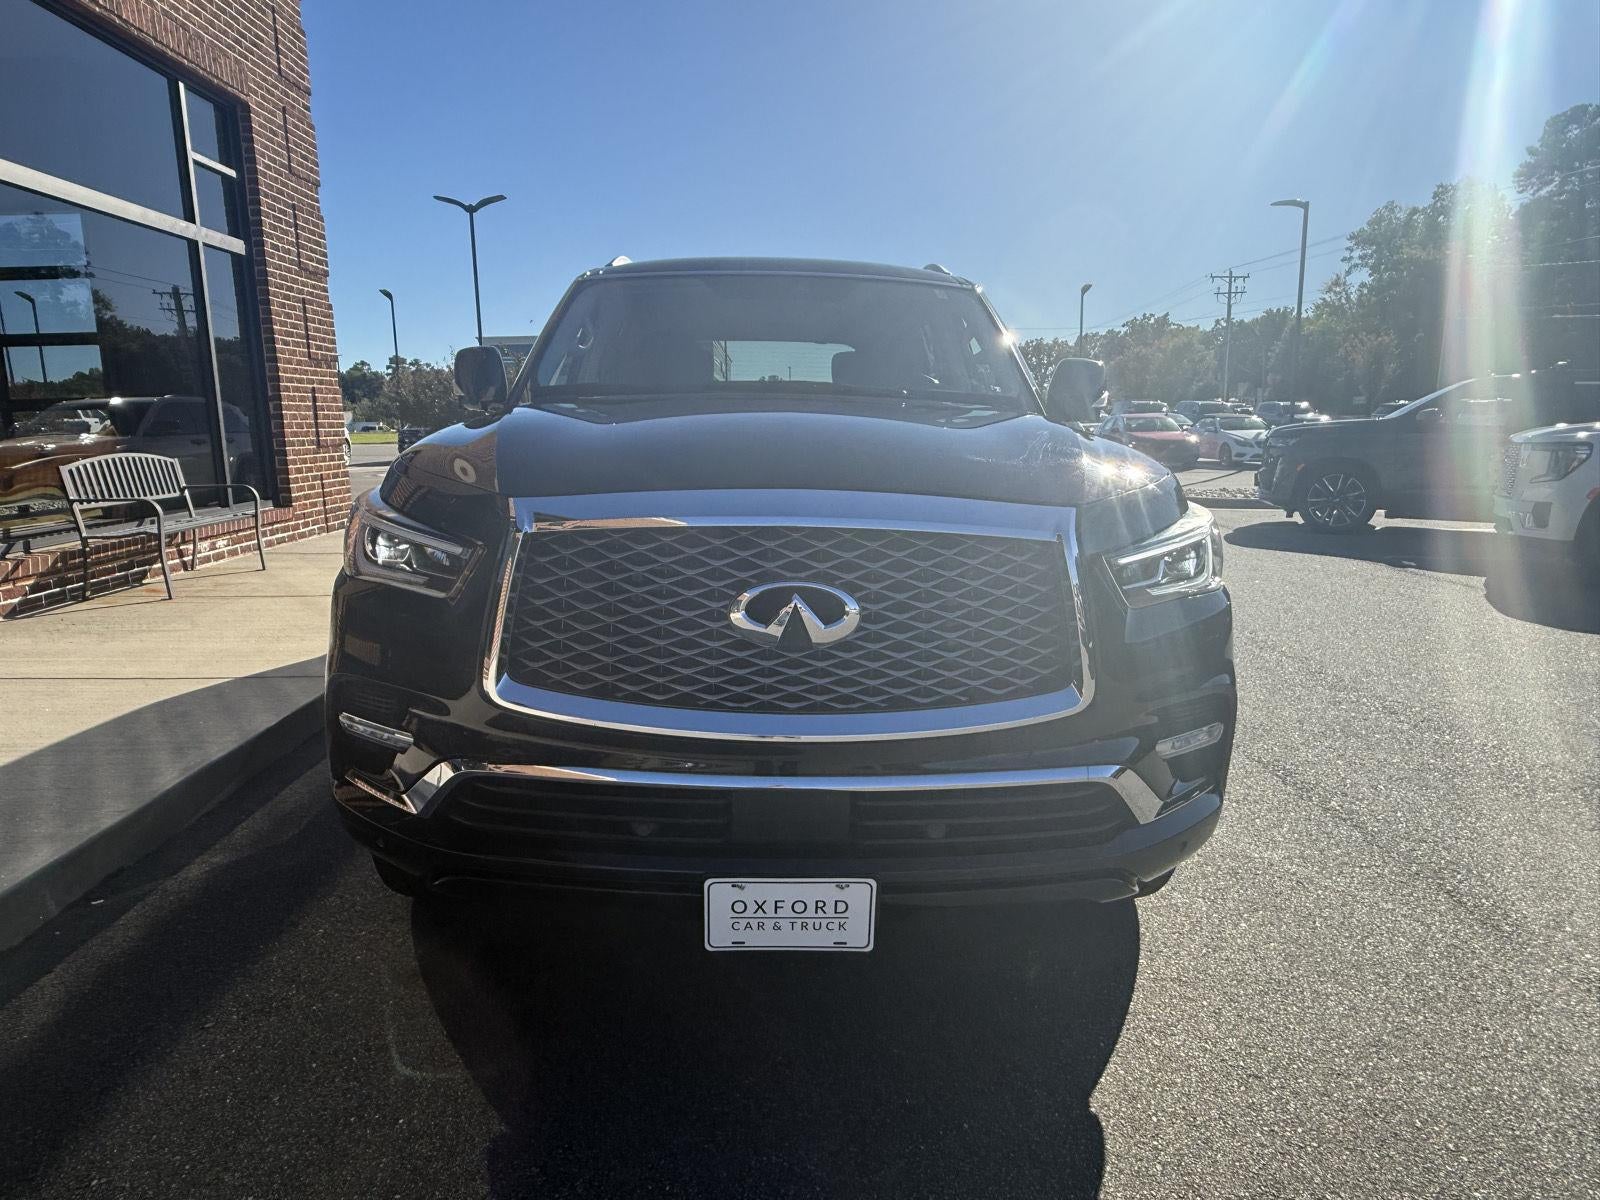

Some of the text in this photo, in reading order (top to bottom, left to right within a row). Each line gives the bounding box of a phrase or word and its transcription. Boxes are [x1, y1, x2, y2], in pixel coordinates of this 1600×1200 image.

[731, 900, 849, 915] OXFORD
[731, 921, 847, 931] CAR & TRUCK
